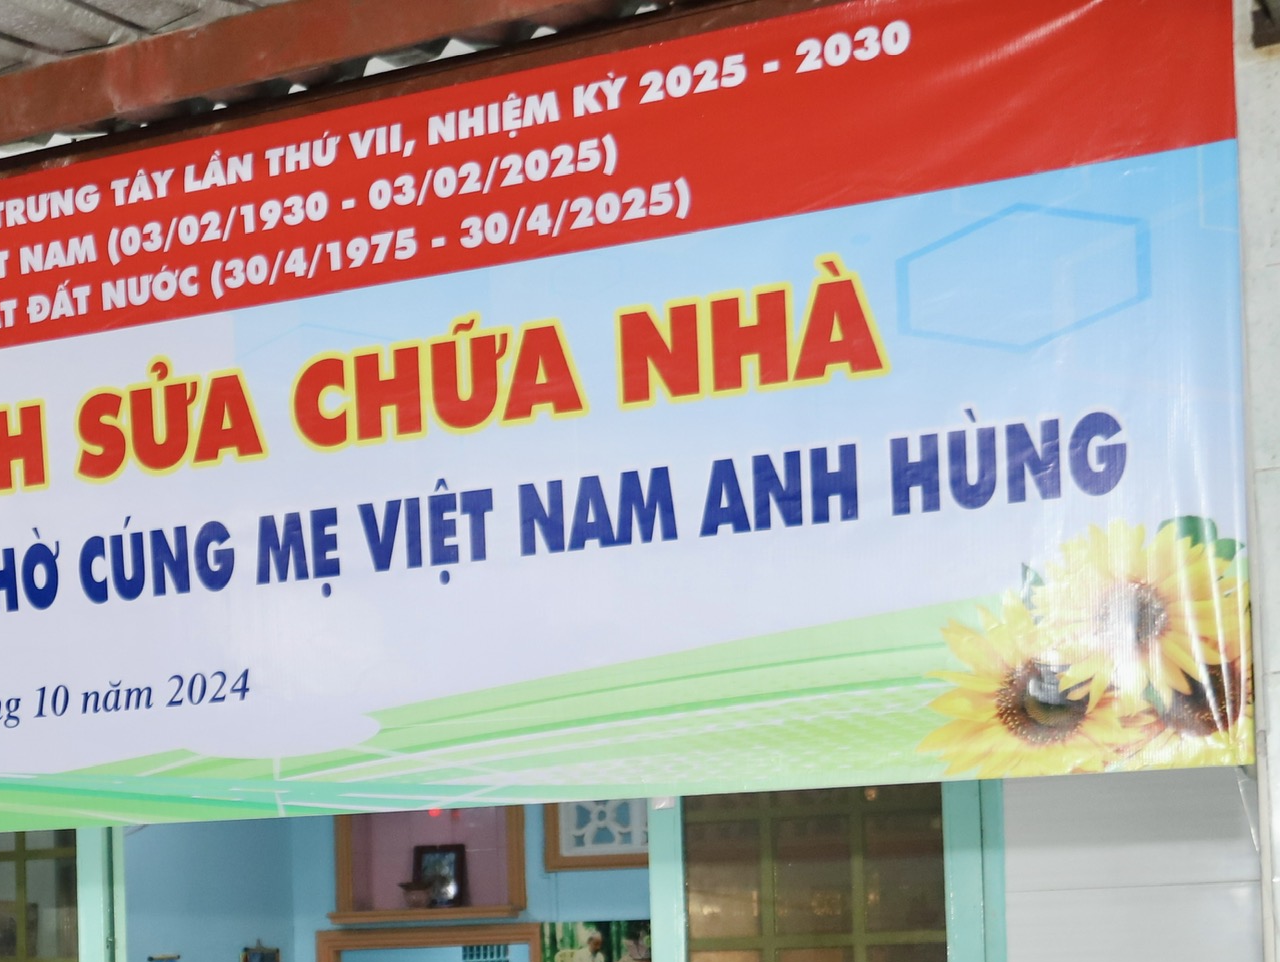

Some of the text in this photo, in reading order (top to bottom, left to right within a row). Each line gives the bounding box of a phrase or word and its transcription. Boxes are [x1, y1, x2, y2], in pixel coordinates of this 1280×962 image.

[110, 169, 175, 206] TÂY
[183, 150, 253, 193] LẦN
[265, 131, 341, 177] THỨ
[349, 122, 416, 158] VII,
[427, 93, 559, 146] NHIỆM
[573, 72, 627, 118] KỲ
[638, 54, 747, 105] 2025
[794, 19, 911, 75] 2030
[19, 235, 97, 275] NAM
[107, 191, 329, 266] (03/02/1930
[368, 134, 618, 211] 03/02/2025)
[26, 279, 91, 324] ĐẤT
[102, 265, 199, 311] NƯỚC
[210, 228, 417, 299] (30/4/1975
[460, 177, 691, 249] 30/4/2025)
[76, 360, 265, 480] SỬA
[293, 319, 585, 448] CHỮA
[618, 260, 885, 406] NHÀ
[79, 515, 235, 605] CÚNG
[256, 507, 342, 599] MẸ
[357, 478, 494, 586] VIỆT
[519, 466, 678, 557] NAM
[699, 443, 859, 538] ANH
[890, 407, 1128, 517] HÙNG
[33, 684, 69, 718] 10
[80, 680, 154, 715] năm
[165, 668, 251, 709] 2024
